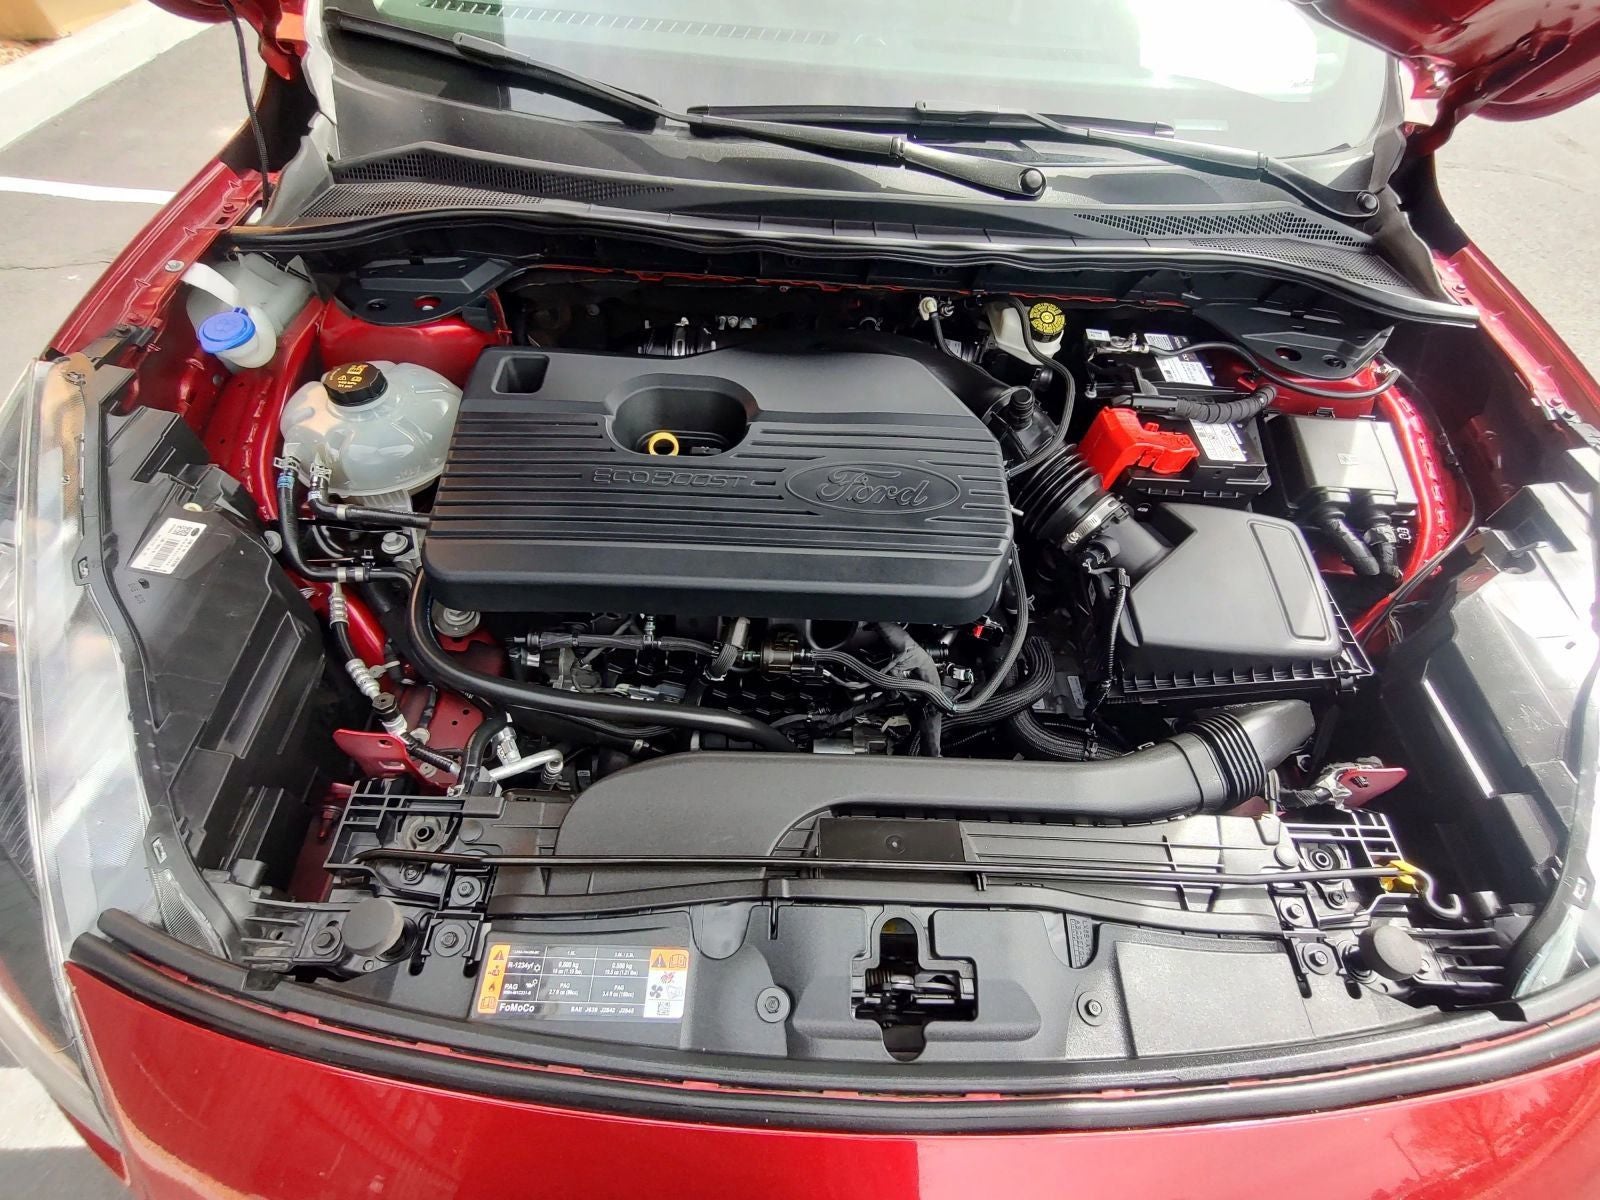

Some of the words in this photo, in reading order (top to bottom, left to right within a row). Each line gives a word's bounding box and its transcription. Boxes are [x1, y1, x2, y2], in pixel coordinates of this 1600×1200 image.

[816, 467, 931, 507] Ford
[507, 961, 535, 971] R-1234yf
[498, 1002, 536, 1013] FoMoCo
